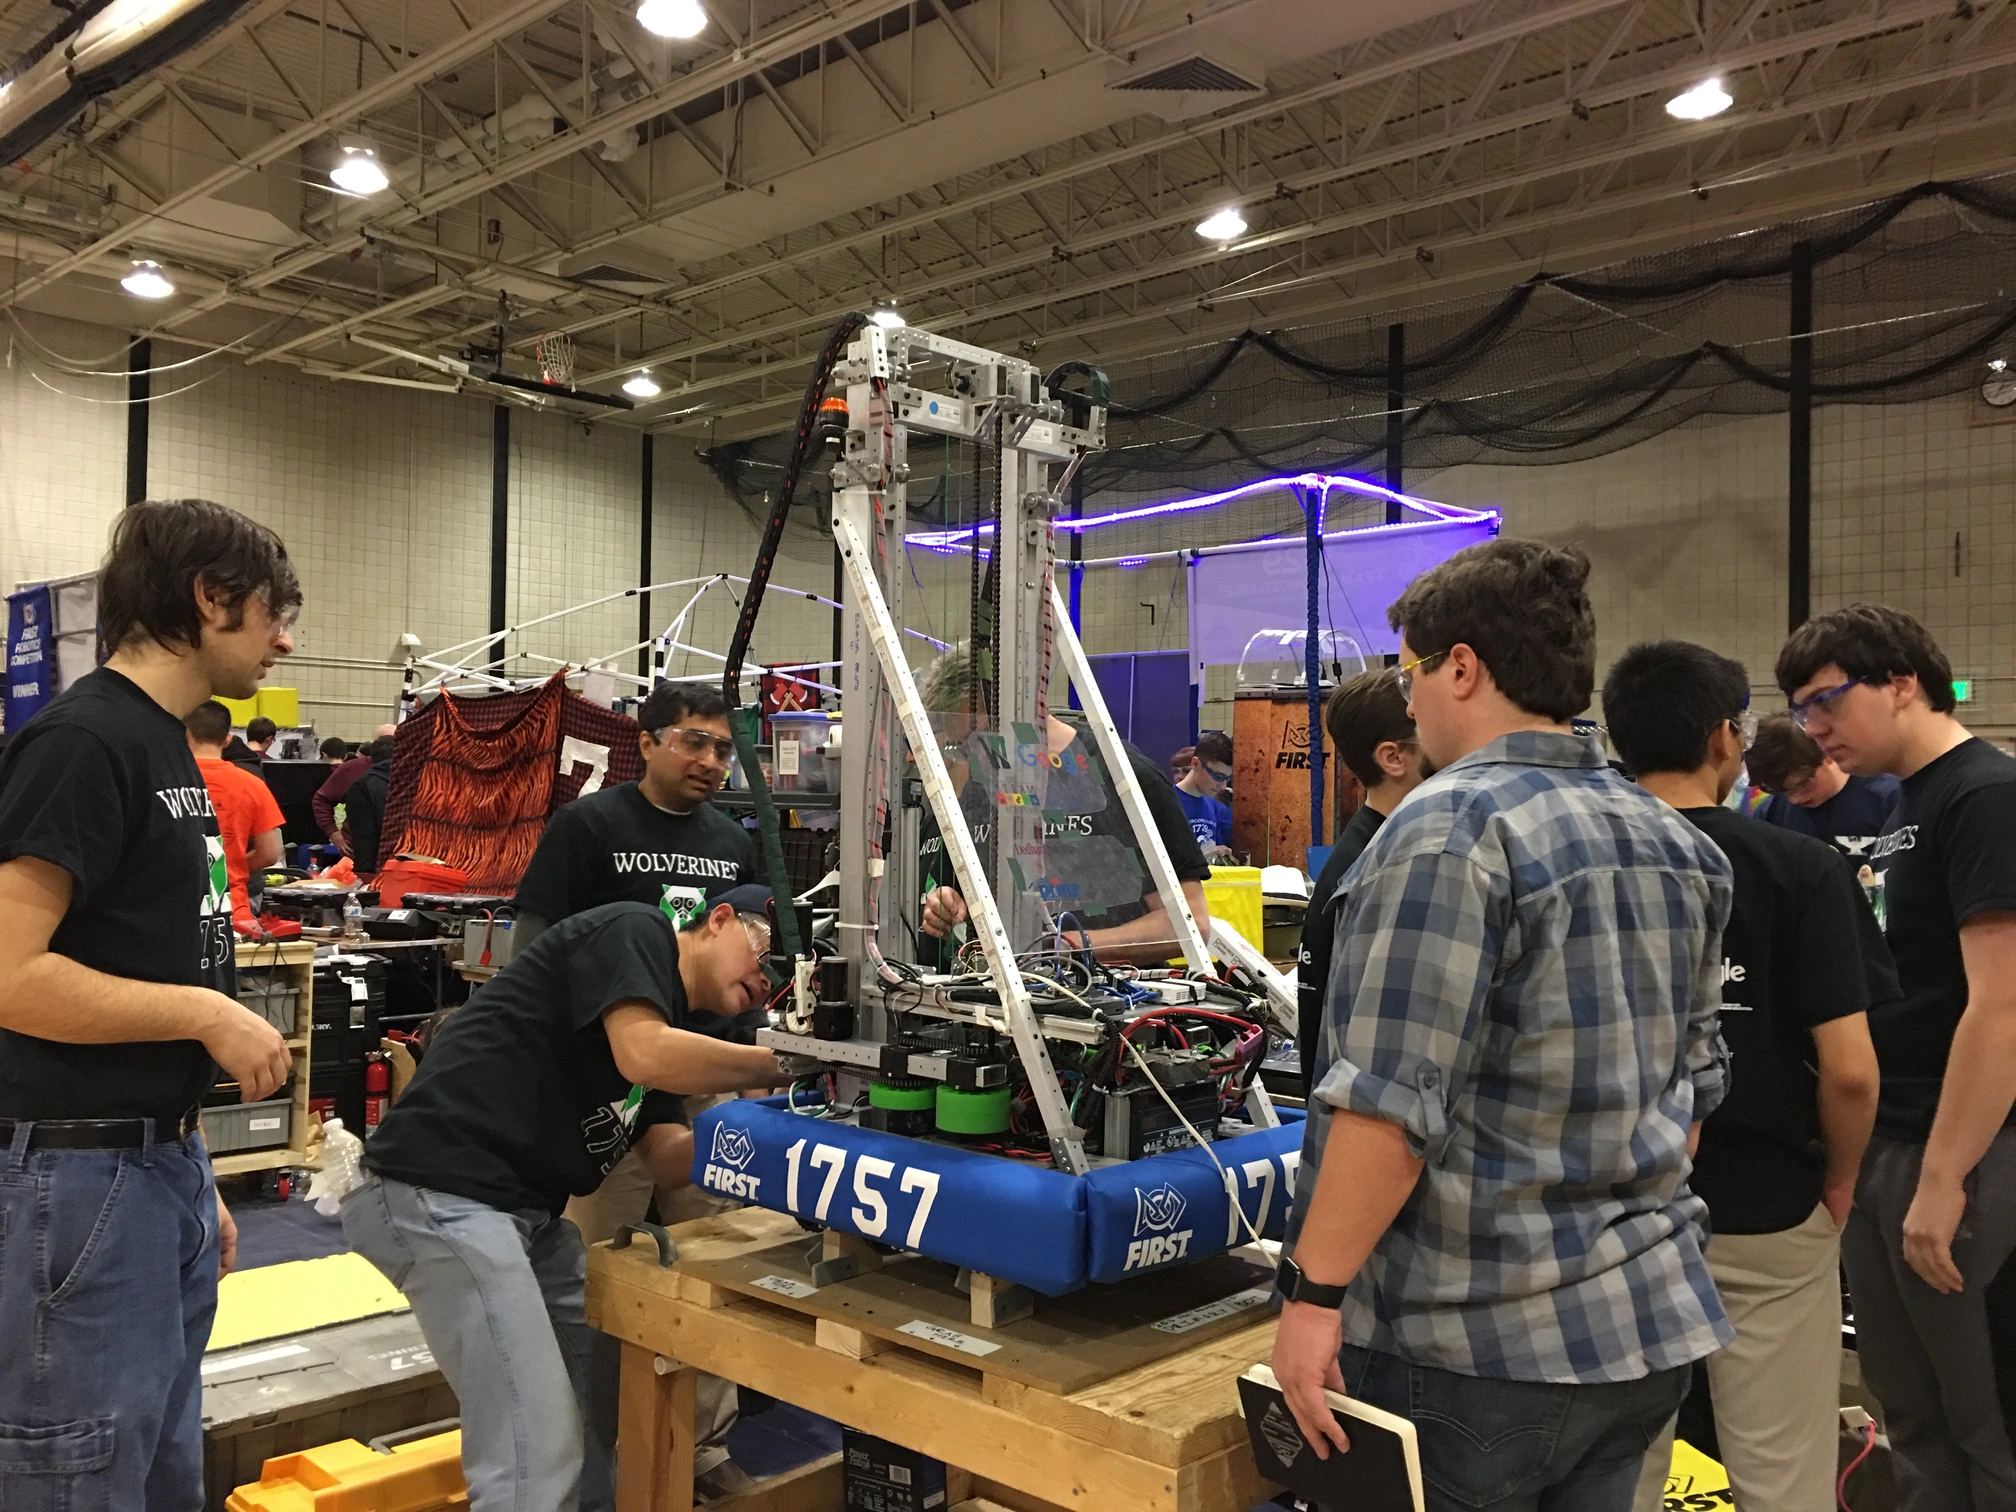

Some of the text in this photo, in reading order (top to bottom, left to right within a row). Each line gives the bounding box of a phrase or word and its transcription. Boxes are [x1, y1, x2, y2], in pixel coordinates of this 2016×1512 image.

[1275, 751, 1331, 770] FIRT
[612, 852, 740, 881] WOLVERINES
[703, 1163, 761, 1200] FIRST
[785, 1138, 941, 1249] 1757
[1225, 1150, 1301, 1247] 175
[1123, 1229, 1194, 1271] FIRST
